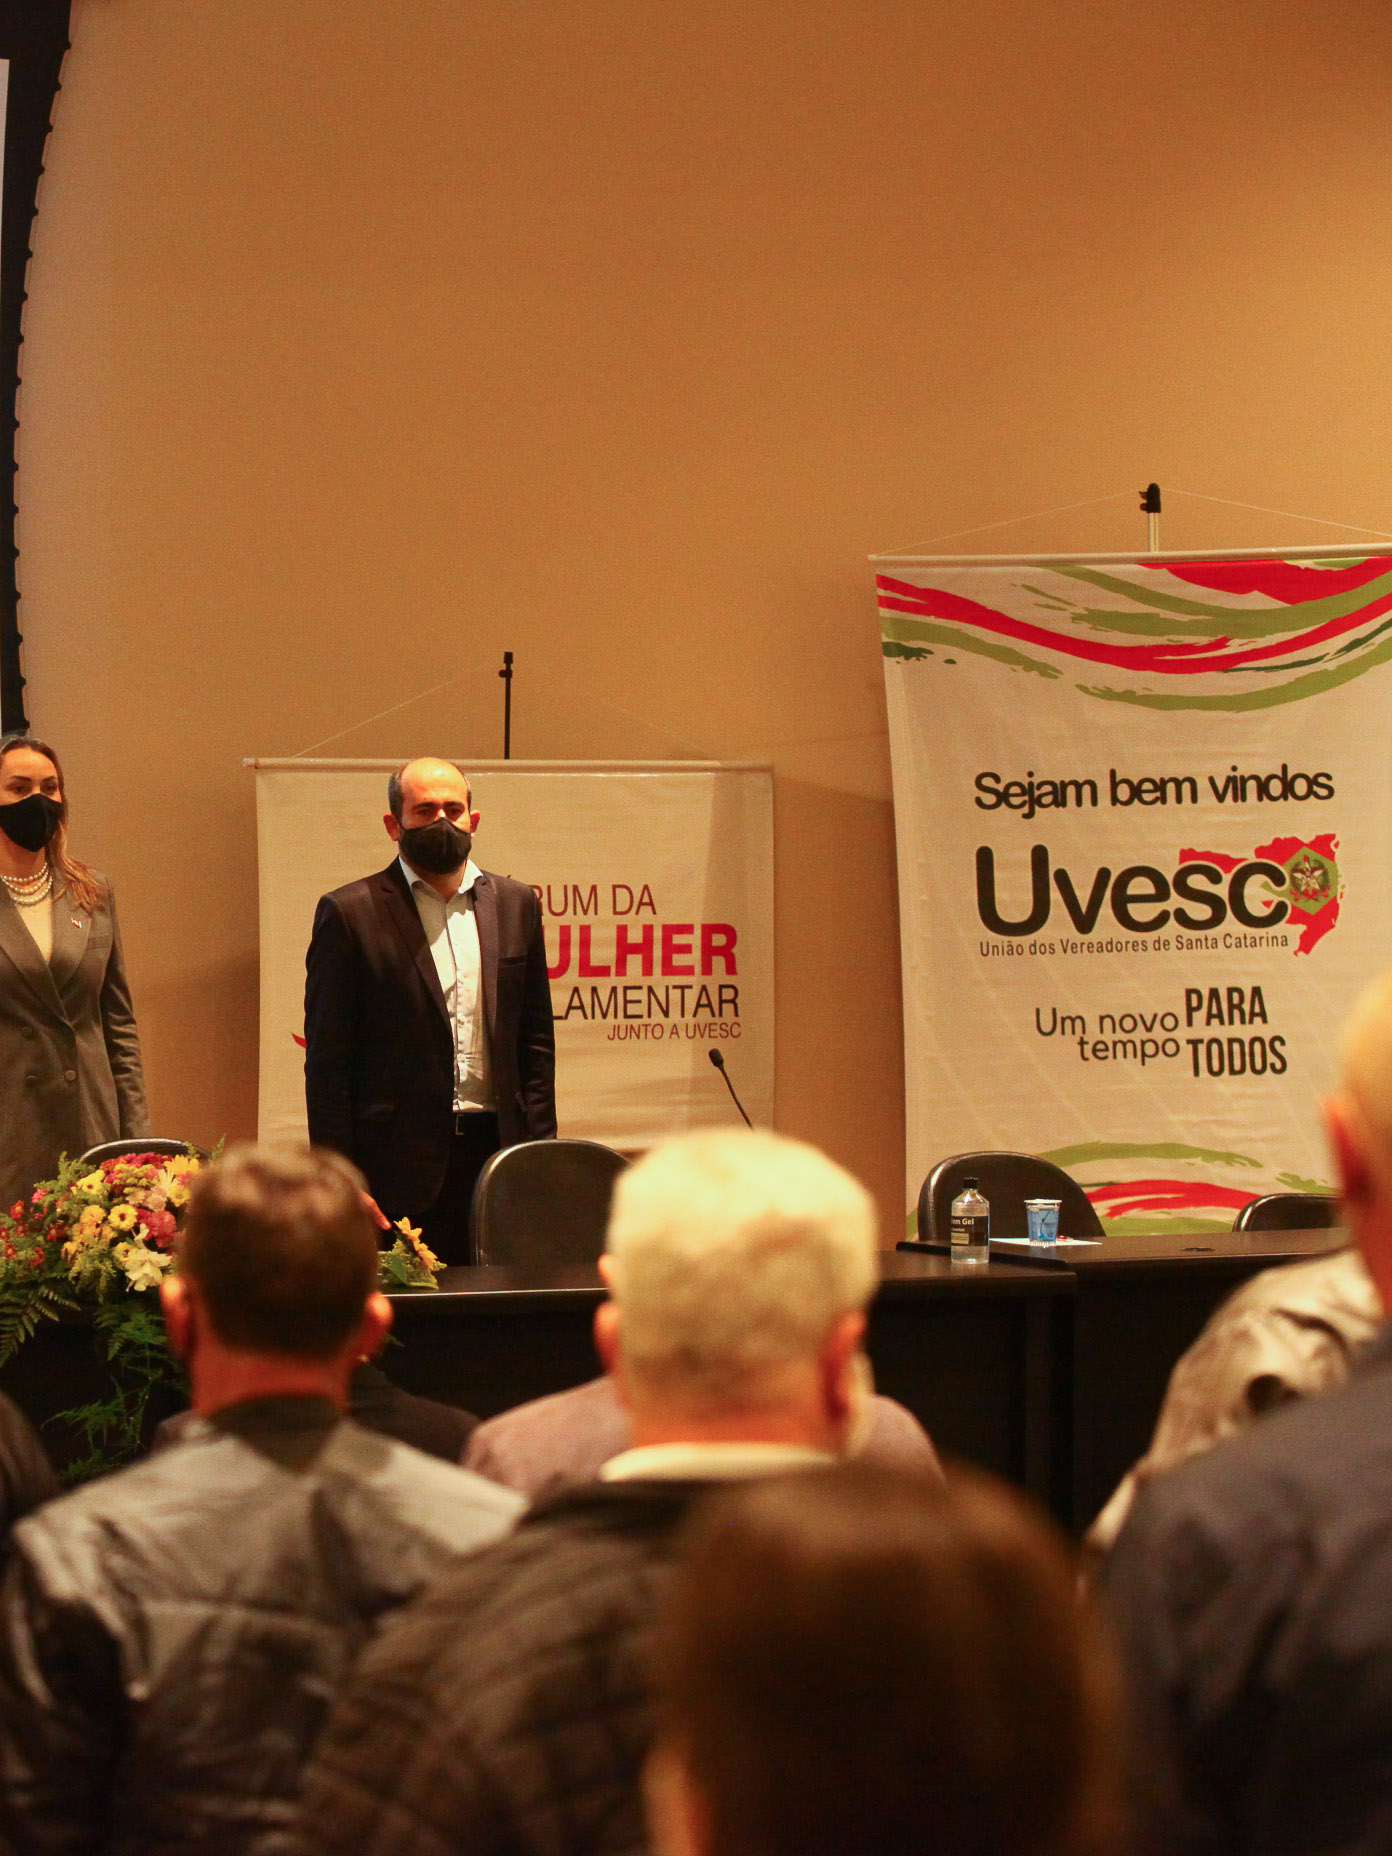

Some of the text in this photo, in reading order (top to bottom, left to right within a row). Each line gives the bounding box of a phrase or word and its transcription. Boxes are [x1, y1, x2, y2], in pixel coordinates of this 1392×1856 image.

[975, 763, 1335, 819] Sejam bem vindos
[612, 884, 657, 916] DA
[975, 844, 1290, 937] Uvesc
[541, 923, 739, 980] ULHER
[980, 931, 1289, 957] União dos Vereadores de Santa Catarina
[1035, 1007, 1180, 1037] Um novo
[1185, 986, 1268, 1028] PARA
[607, 1022, 742, 1041] JUNTO A UVESC
[1078, 1036, 1181, 1066] tempo
[1186, 1034, 1288, 1078] TODOS
[962, 1217, 975, 1226] Gel
